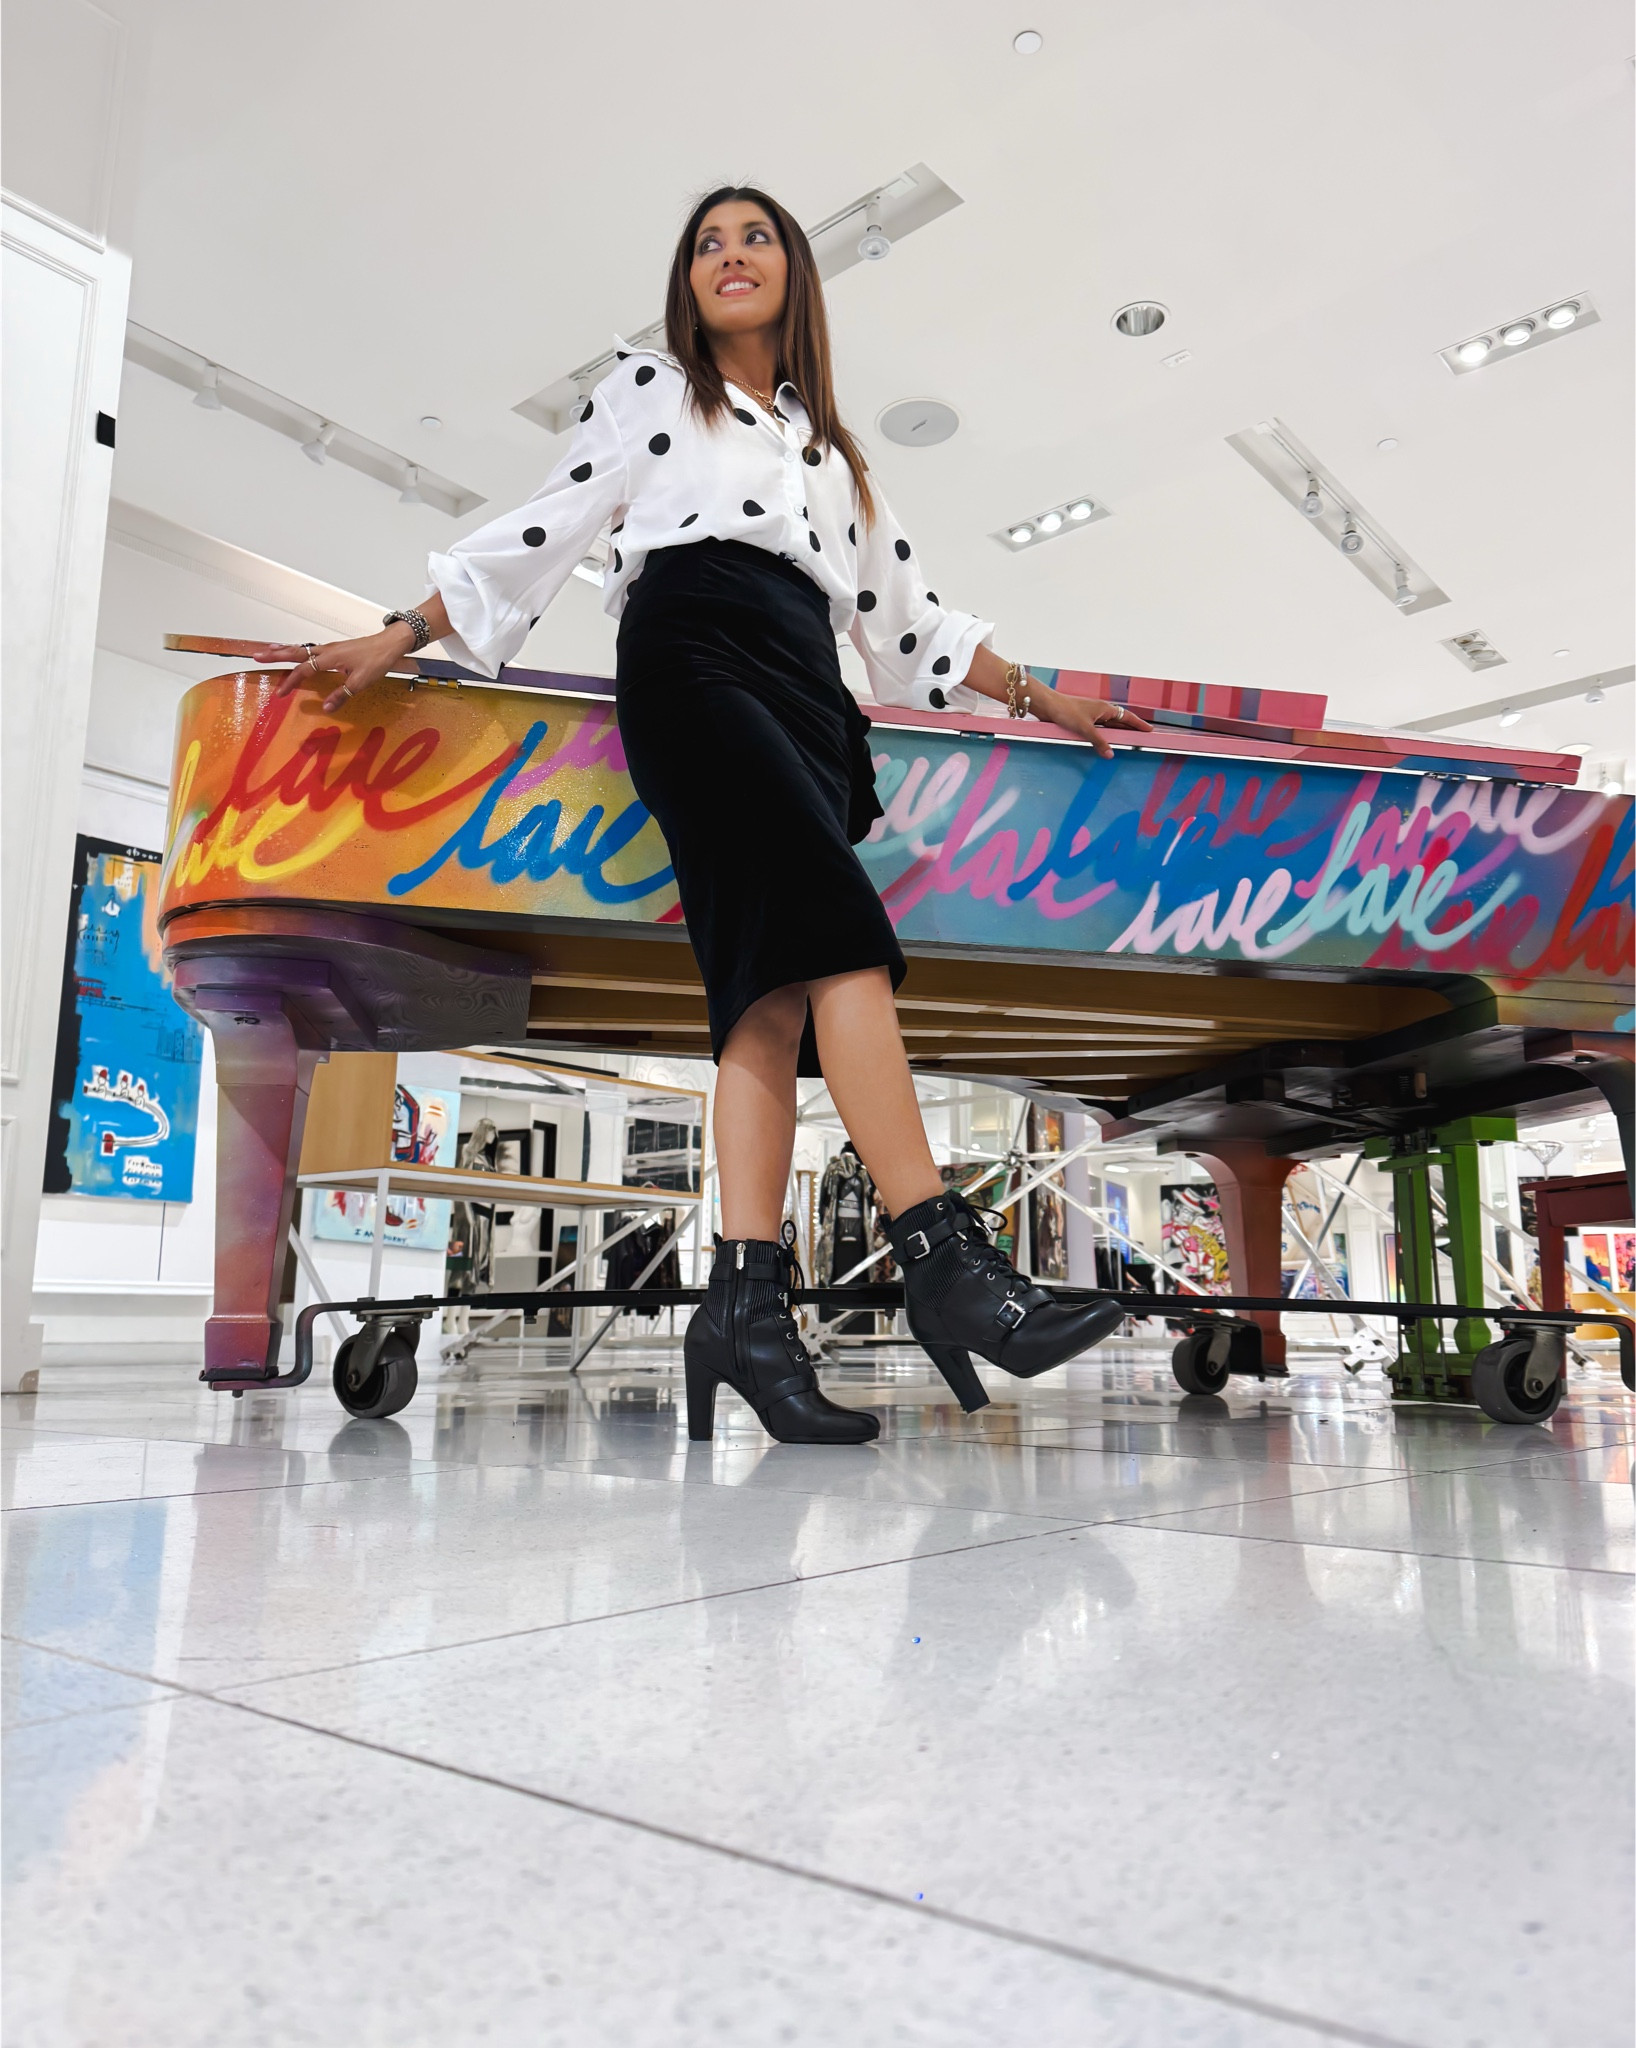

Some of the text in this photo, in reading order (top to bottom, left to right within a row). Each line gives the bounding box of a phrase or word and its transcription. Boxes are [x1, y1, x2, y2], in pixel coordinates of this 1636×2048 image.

[190, 672, 525, 831] love
[386, 719, 680, 904] love
[1267, 801, 1523, 951] love
